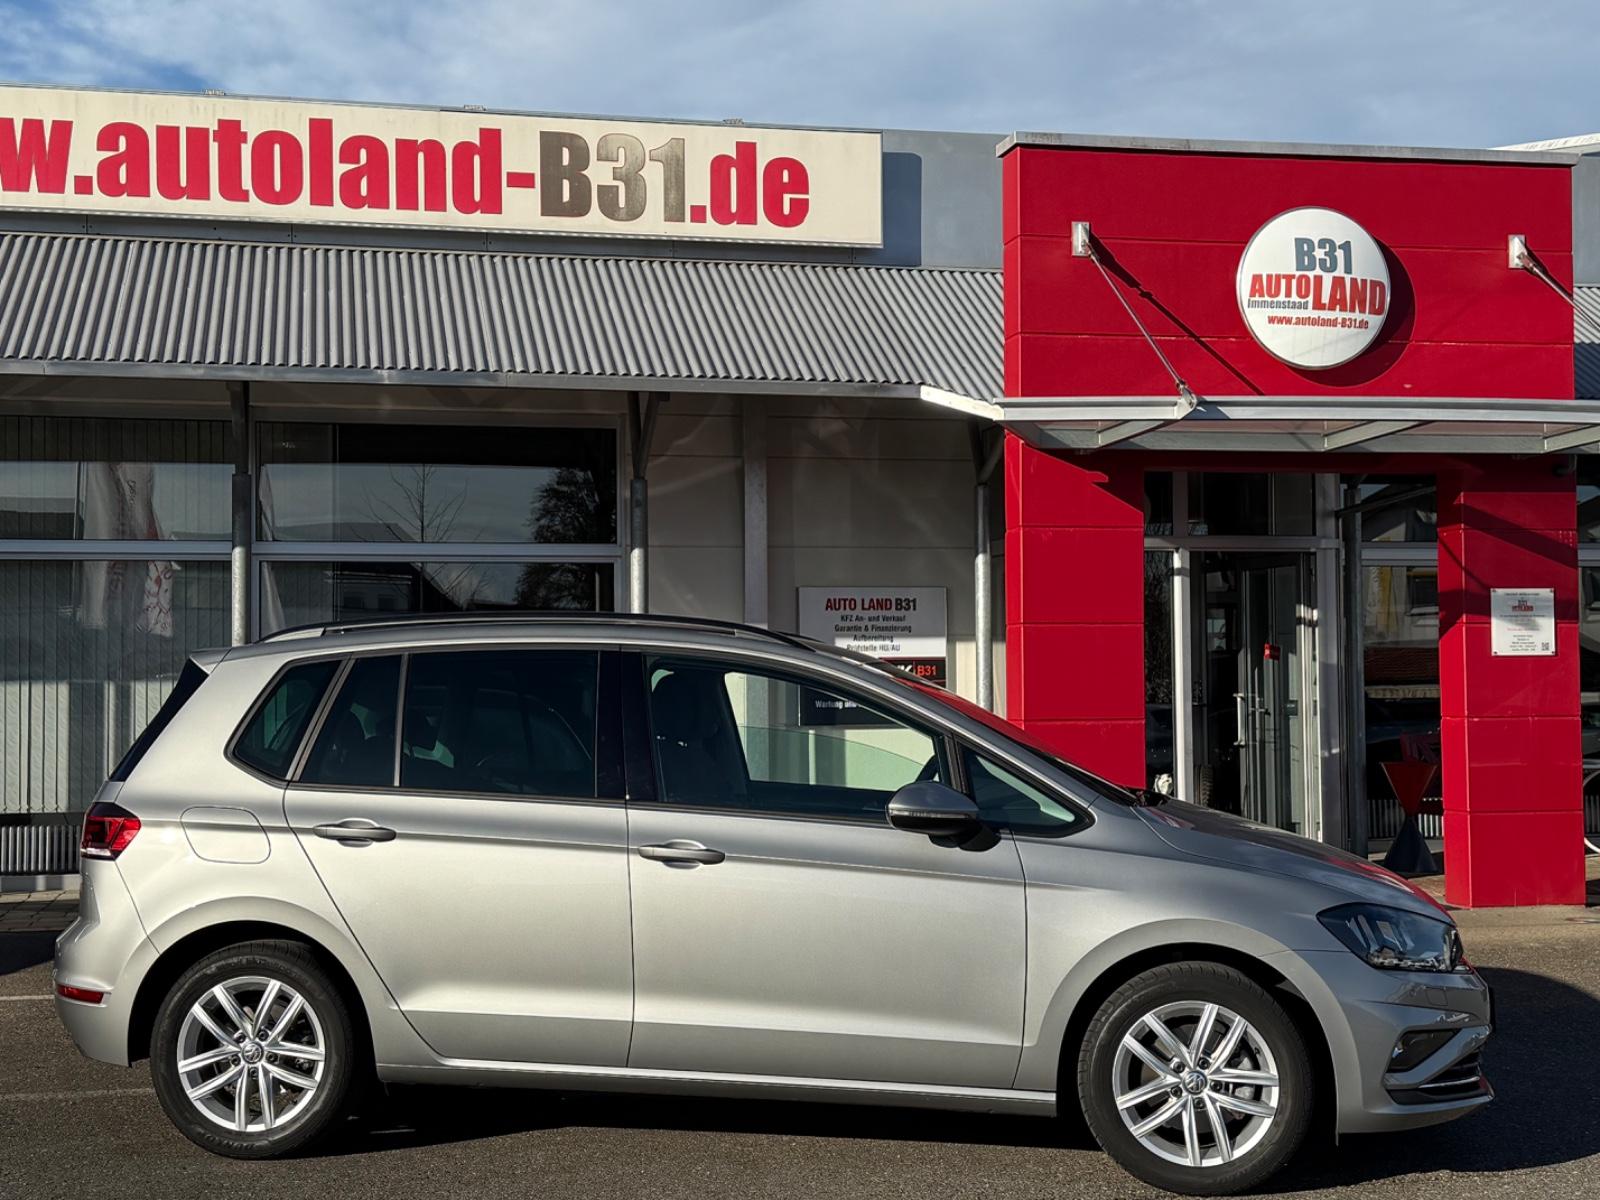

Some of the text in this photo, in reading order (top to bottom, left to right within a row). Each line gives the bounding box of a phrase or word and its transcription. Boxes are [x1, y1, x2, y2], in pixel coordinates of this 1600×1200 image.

[1294, 237, 1352, 274] B31
[1247, 298, 1308, 310] Immenstaad
[1267, 315, 1369, 329] www.autoland-B31.de
[825, 597, 917, 611] AUTO LAND B31
[840, 614, 854, 622] KFZ
[867, 614, 881, 622] und
[881, 614, 906, 622] Verkauf
[834, 624, 862, 632] Garantie
[871, 624, 912, 633] Finanzierung
[853, 634, 894, 643] Aufbereitung
[917, 665, 937, 676] B31
[815, 700, 843, 709] Wartung
